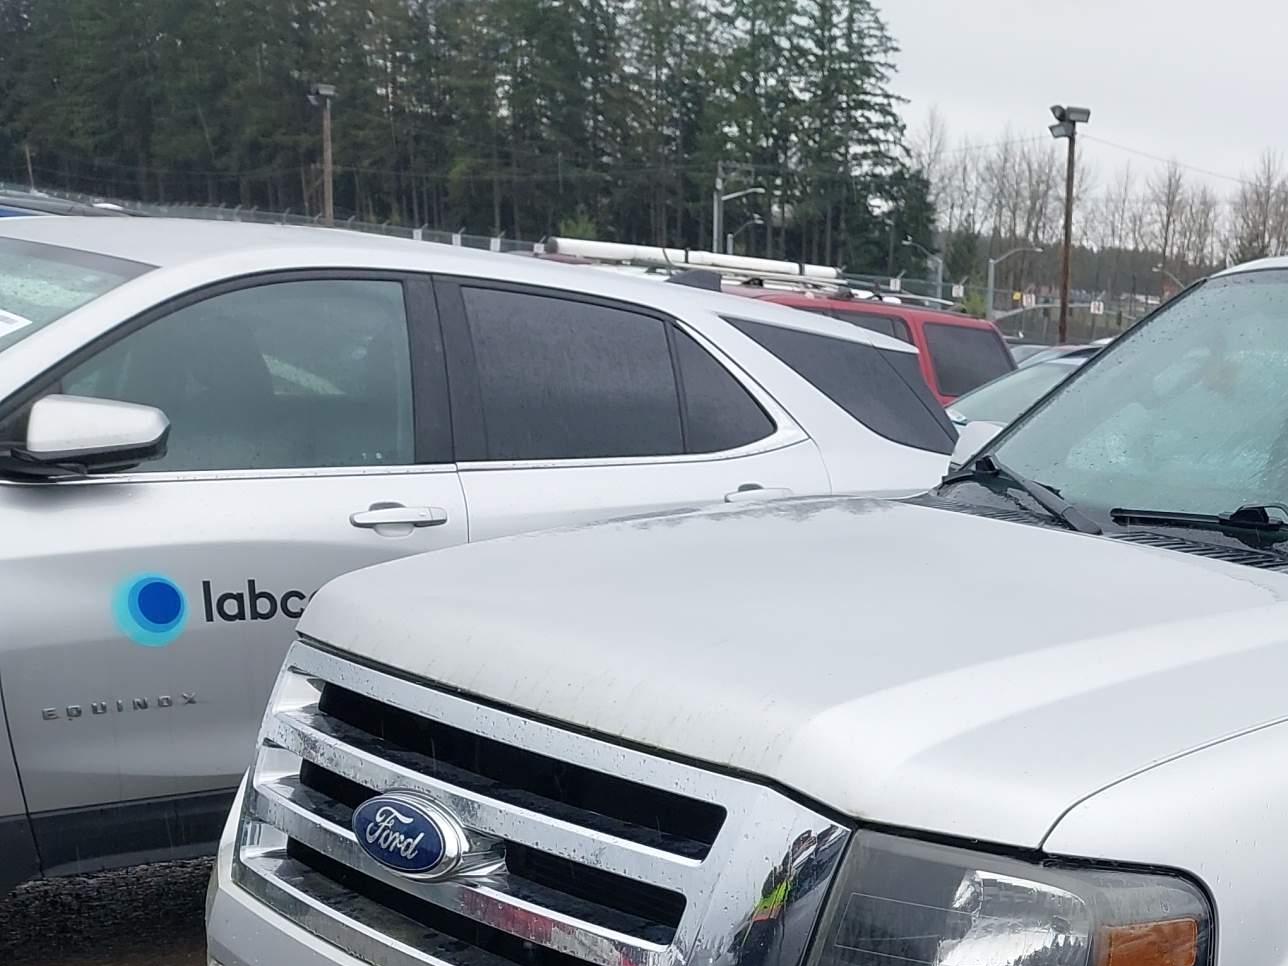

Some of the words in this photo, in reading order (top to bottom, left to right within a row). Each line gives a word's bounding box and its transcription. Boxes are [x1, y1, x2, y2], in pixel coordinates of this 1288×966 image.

[201, 579, 318, 623] labc
[41, 690, 198, 721] EQUINOX
[366, 806, 425, 860] Ford
